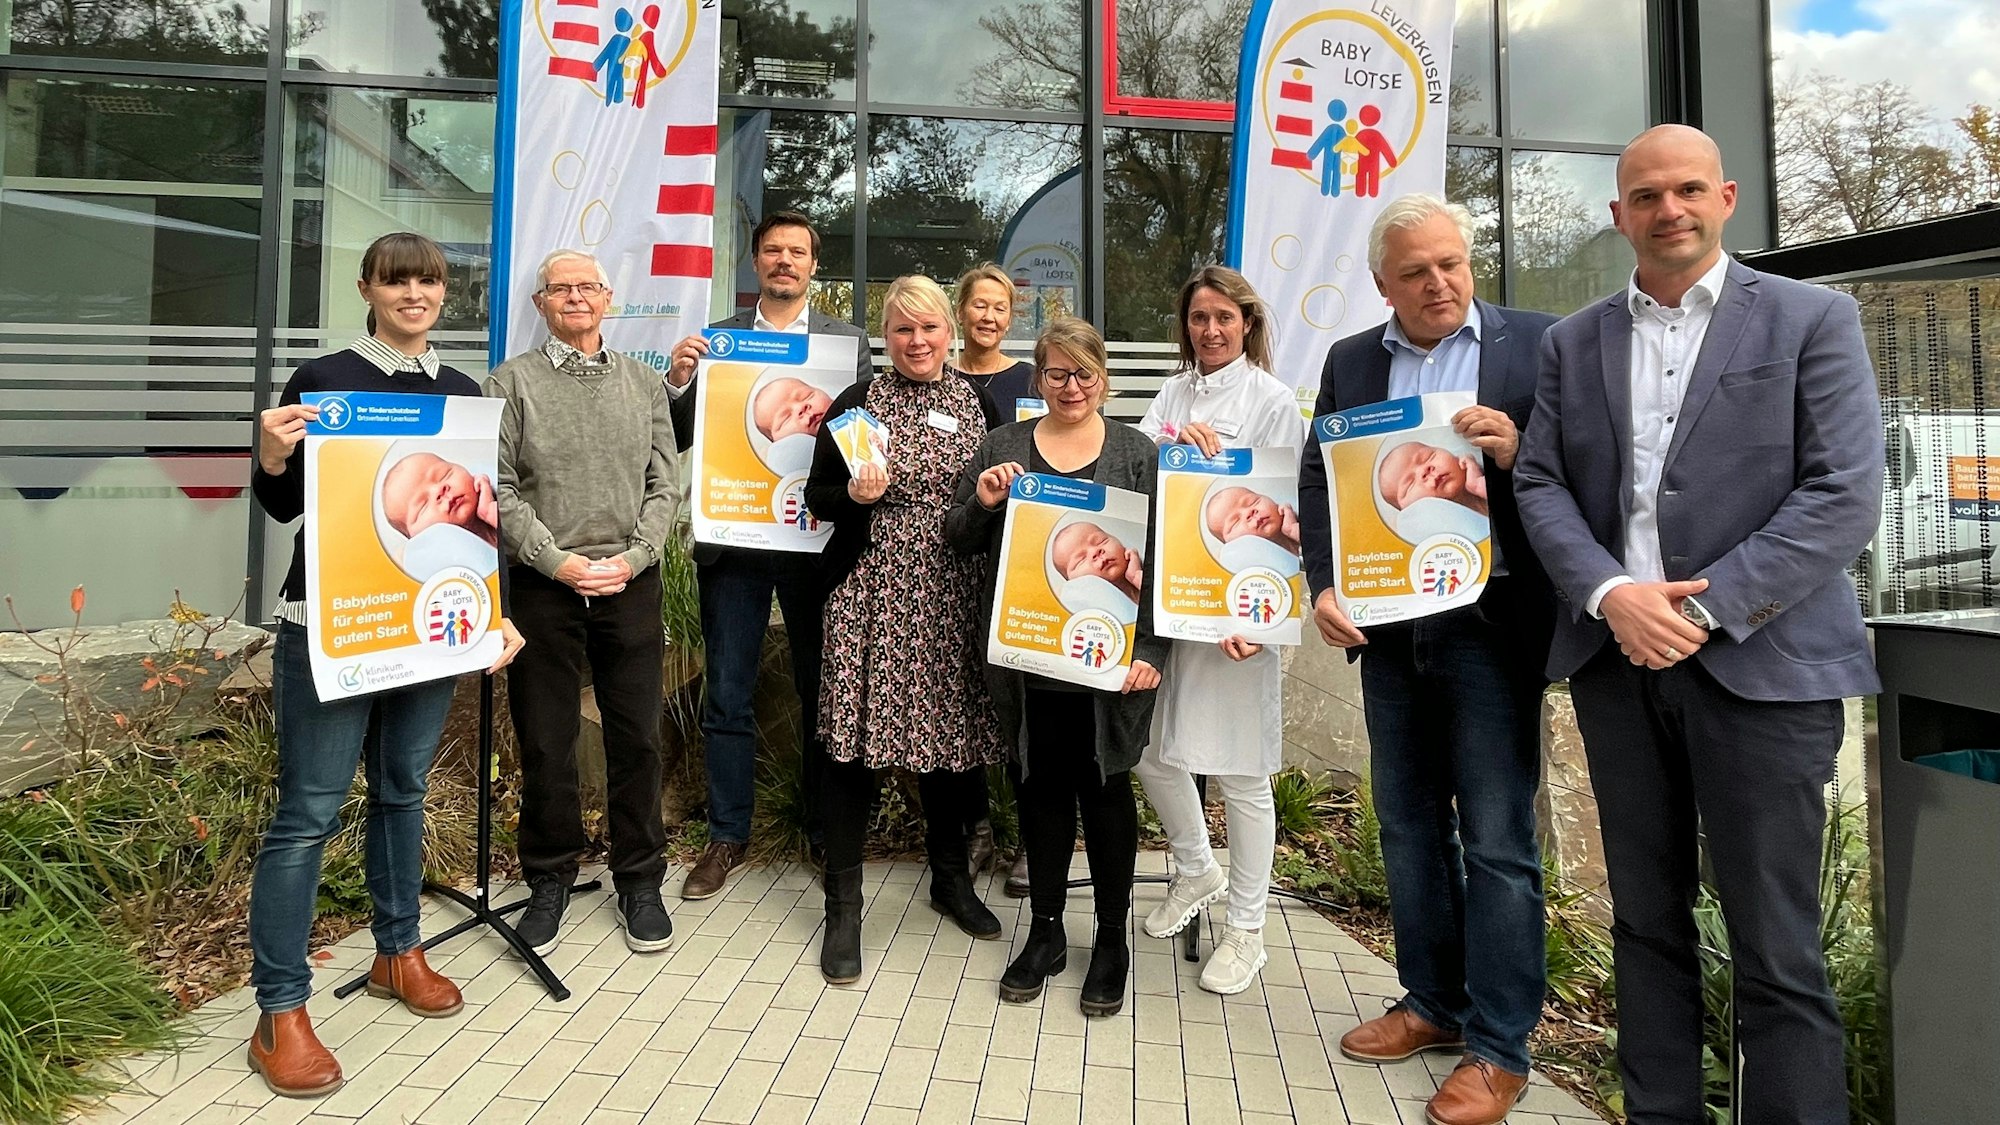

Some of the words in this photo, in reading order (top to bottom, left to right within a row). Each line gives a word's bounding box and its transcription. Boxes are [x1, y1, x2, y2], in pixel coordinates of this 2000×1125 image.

[1320, 38, 1371, 62] BABY
[1371, 0, 1442, 104] LEVERKUSEN
[1344, 67, 1402, 90] LOTSE
[624, 303, 641, 315] Start
[642, 303, 654, 314] ins
[656, 302, 681, 314] Leben
[369, 406, 420, 414] Kinderschutzbund
[710, 477, 769, 489] Babylotsen
[710, 490, 725, 500] für
[727, 492, 756, 501] einen
[710, 503, 740, 514] guten
[742, 504, 768, 514] Start
[1347, 551, 1404, 564] Babylotsen
[1443, 558, 1463, 566] LOTSE
[1348, 566, 1361, 577] für
[1363, 565, 1392, 575] einen
[1170, 574, 1223, 586] Babylotsen
[1348, 579, 1377, 592] guten
[1379, 576, 1406, 588] Start
[443, 589, 462, 598] BABY
[459, 571, 486, 604] LEVERKUSEN
[1170, 586, 1183, 596] für
[1185, 587, 1211, 597] einen
[333, 591, 408, 610] Babylotsen
[452, 596, 473, 605] LOTSE
[1169, 599, 1197, 608] guten
[1199, 599, 1223, 609] Start
[333, 614, 353, 628] für
[356, 611, 393, 625] einen
[1008, 606, 1060, 623] Babylotsen
[1007, 617, 1020, 628] für
[1022, 621, 1047, 632] einen
[333, 631, 373, 648] guten
[376, 623, 408, 639] Start
[1005, 631, 1032, 642] guten
[1034, 634, 1057, 647] Start
[1093, 632, 1110, 640] LOTSE
[365, 663, 404, 676] klinikum
[367, 669, 415, 685] leverkusen
